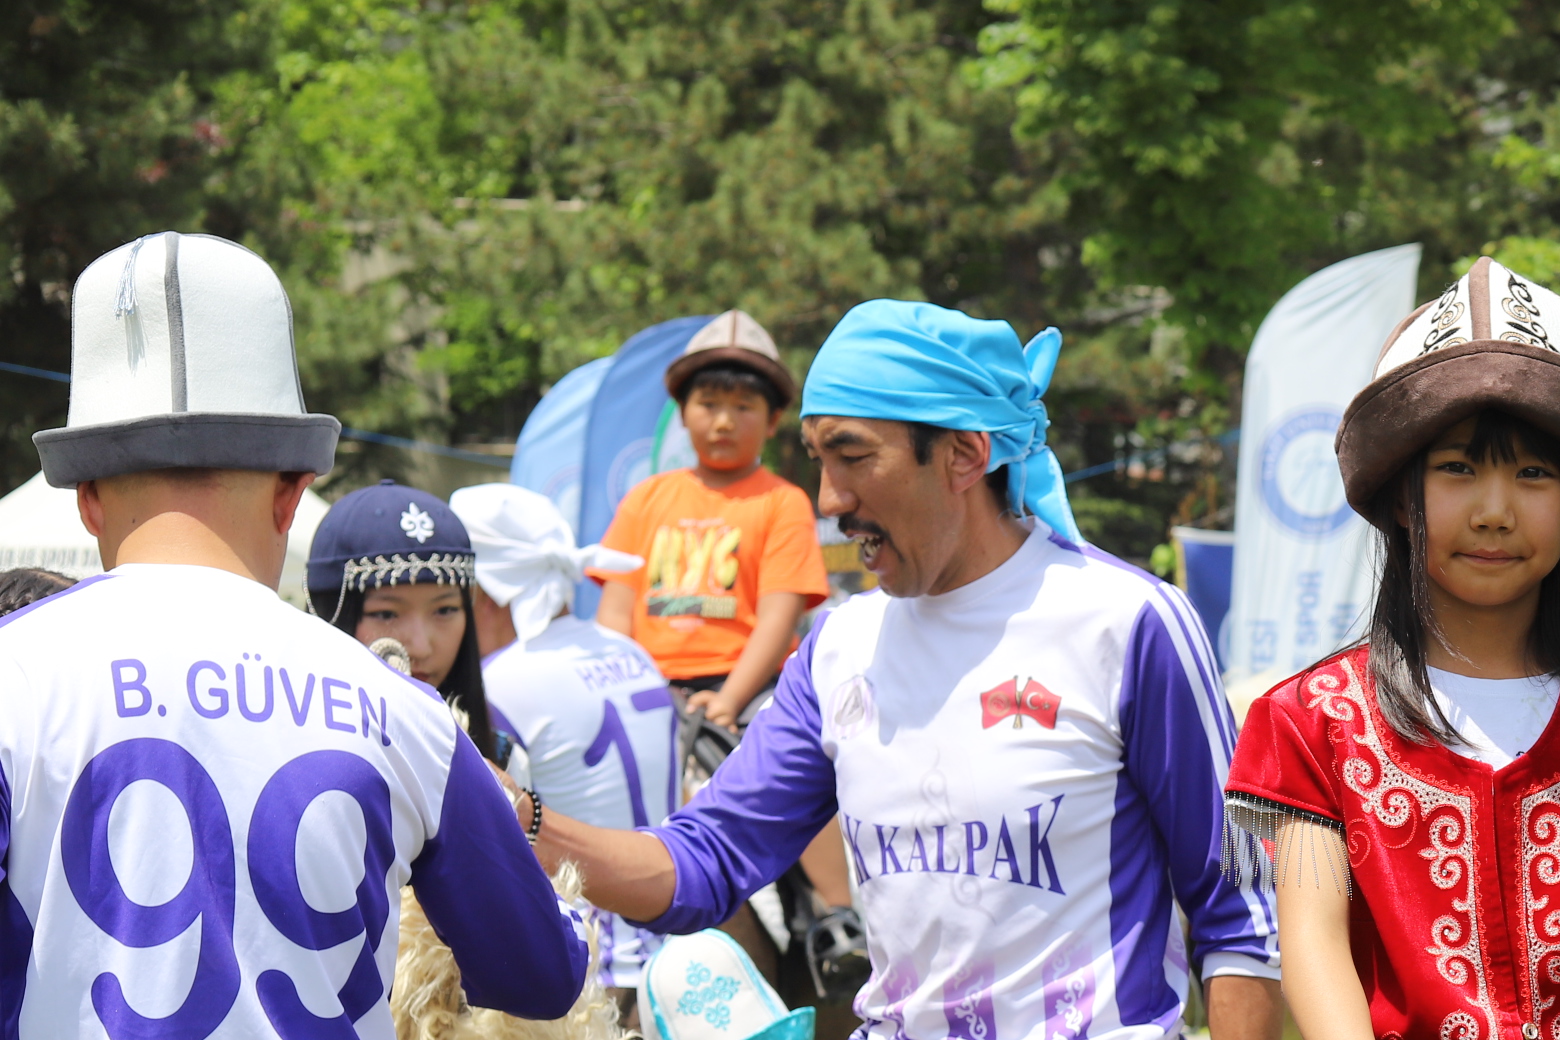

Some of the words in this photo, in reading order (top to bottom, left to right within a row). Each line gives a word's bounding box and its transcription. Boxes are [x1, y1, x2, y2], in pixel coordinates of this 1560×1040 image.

[111, 658, 167, 718] B.
[187, 652, 391, 747] GÜVEN
[584, 686, 678, 826] 17
[872, 793, 1067, 896] KALPAK
